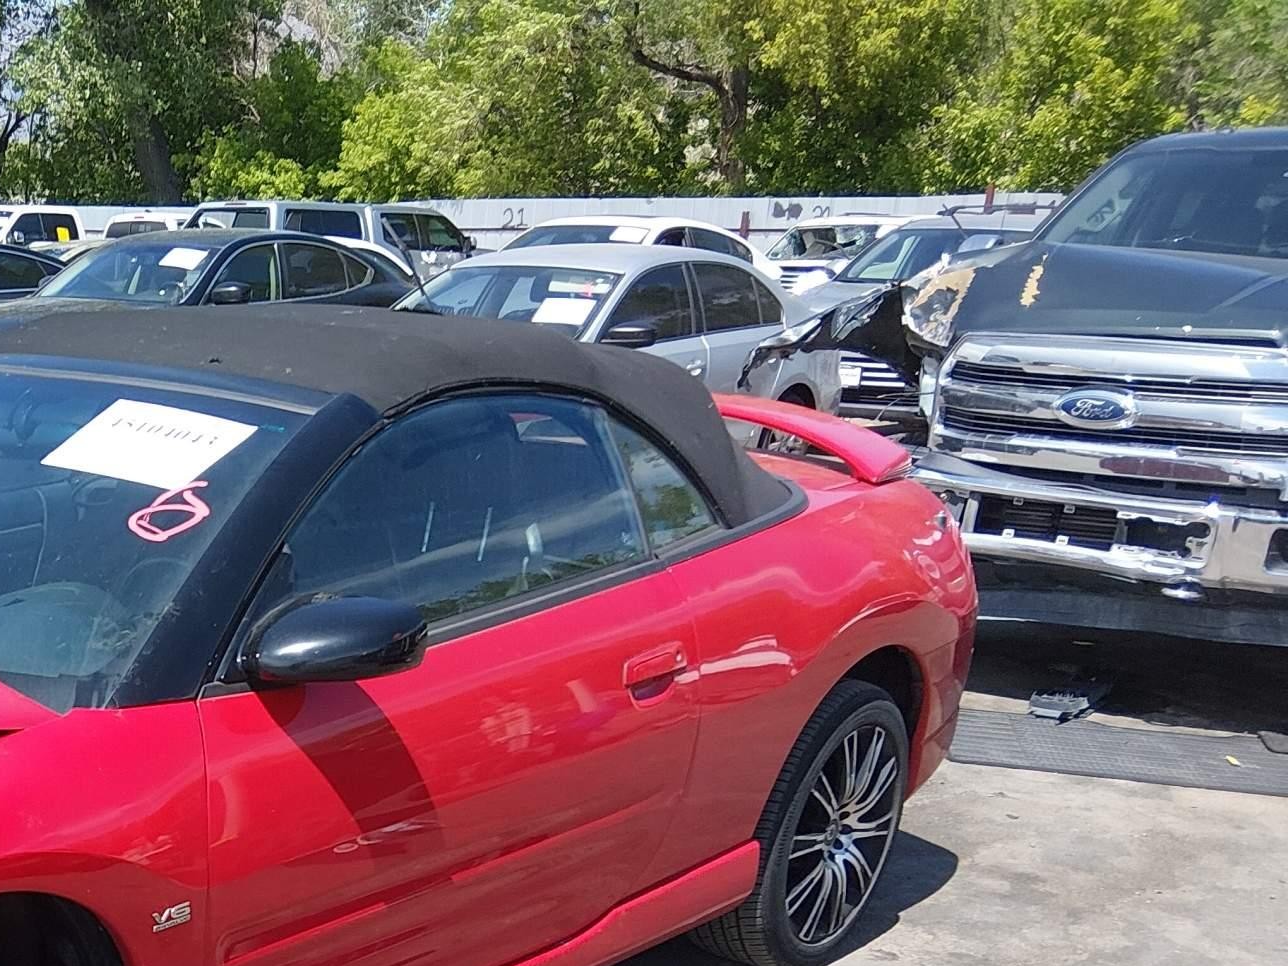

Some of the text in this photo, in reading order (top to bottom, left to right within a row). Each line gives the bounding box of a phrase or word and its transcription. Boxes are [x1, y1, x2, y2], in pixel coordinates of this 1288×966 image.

[503, 207, 528, 229] 21
[1071, 399, 1115, 418] Ford
[152, 901, 191, 924] V6
